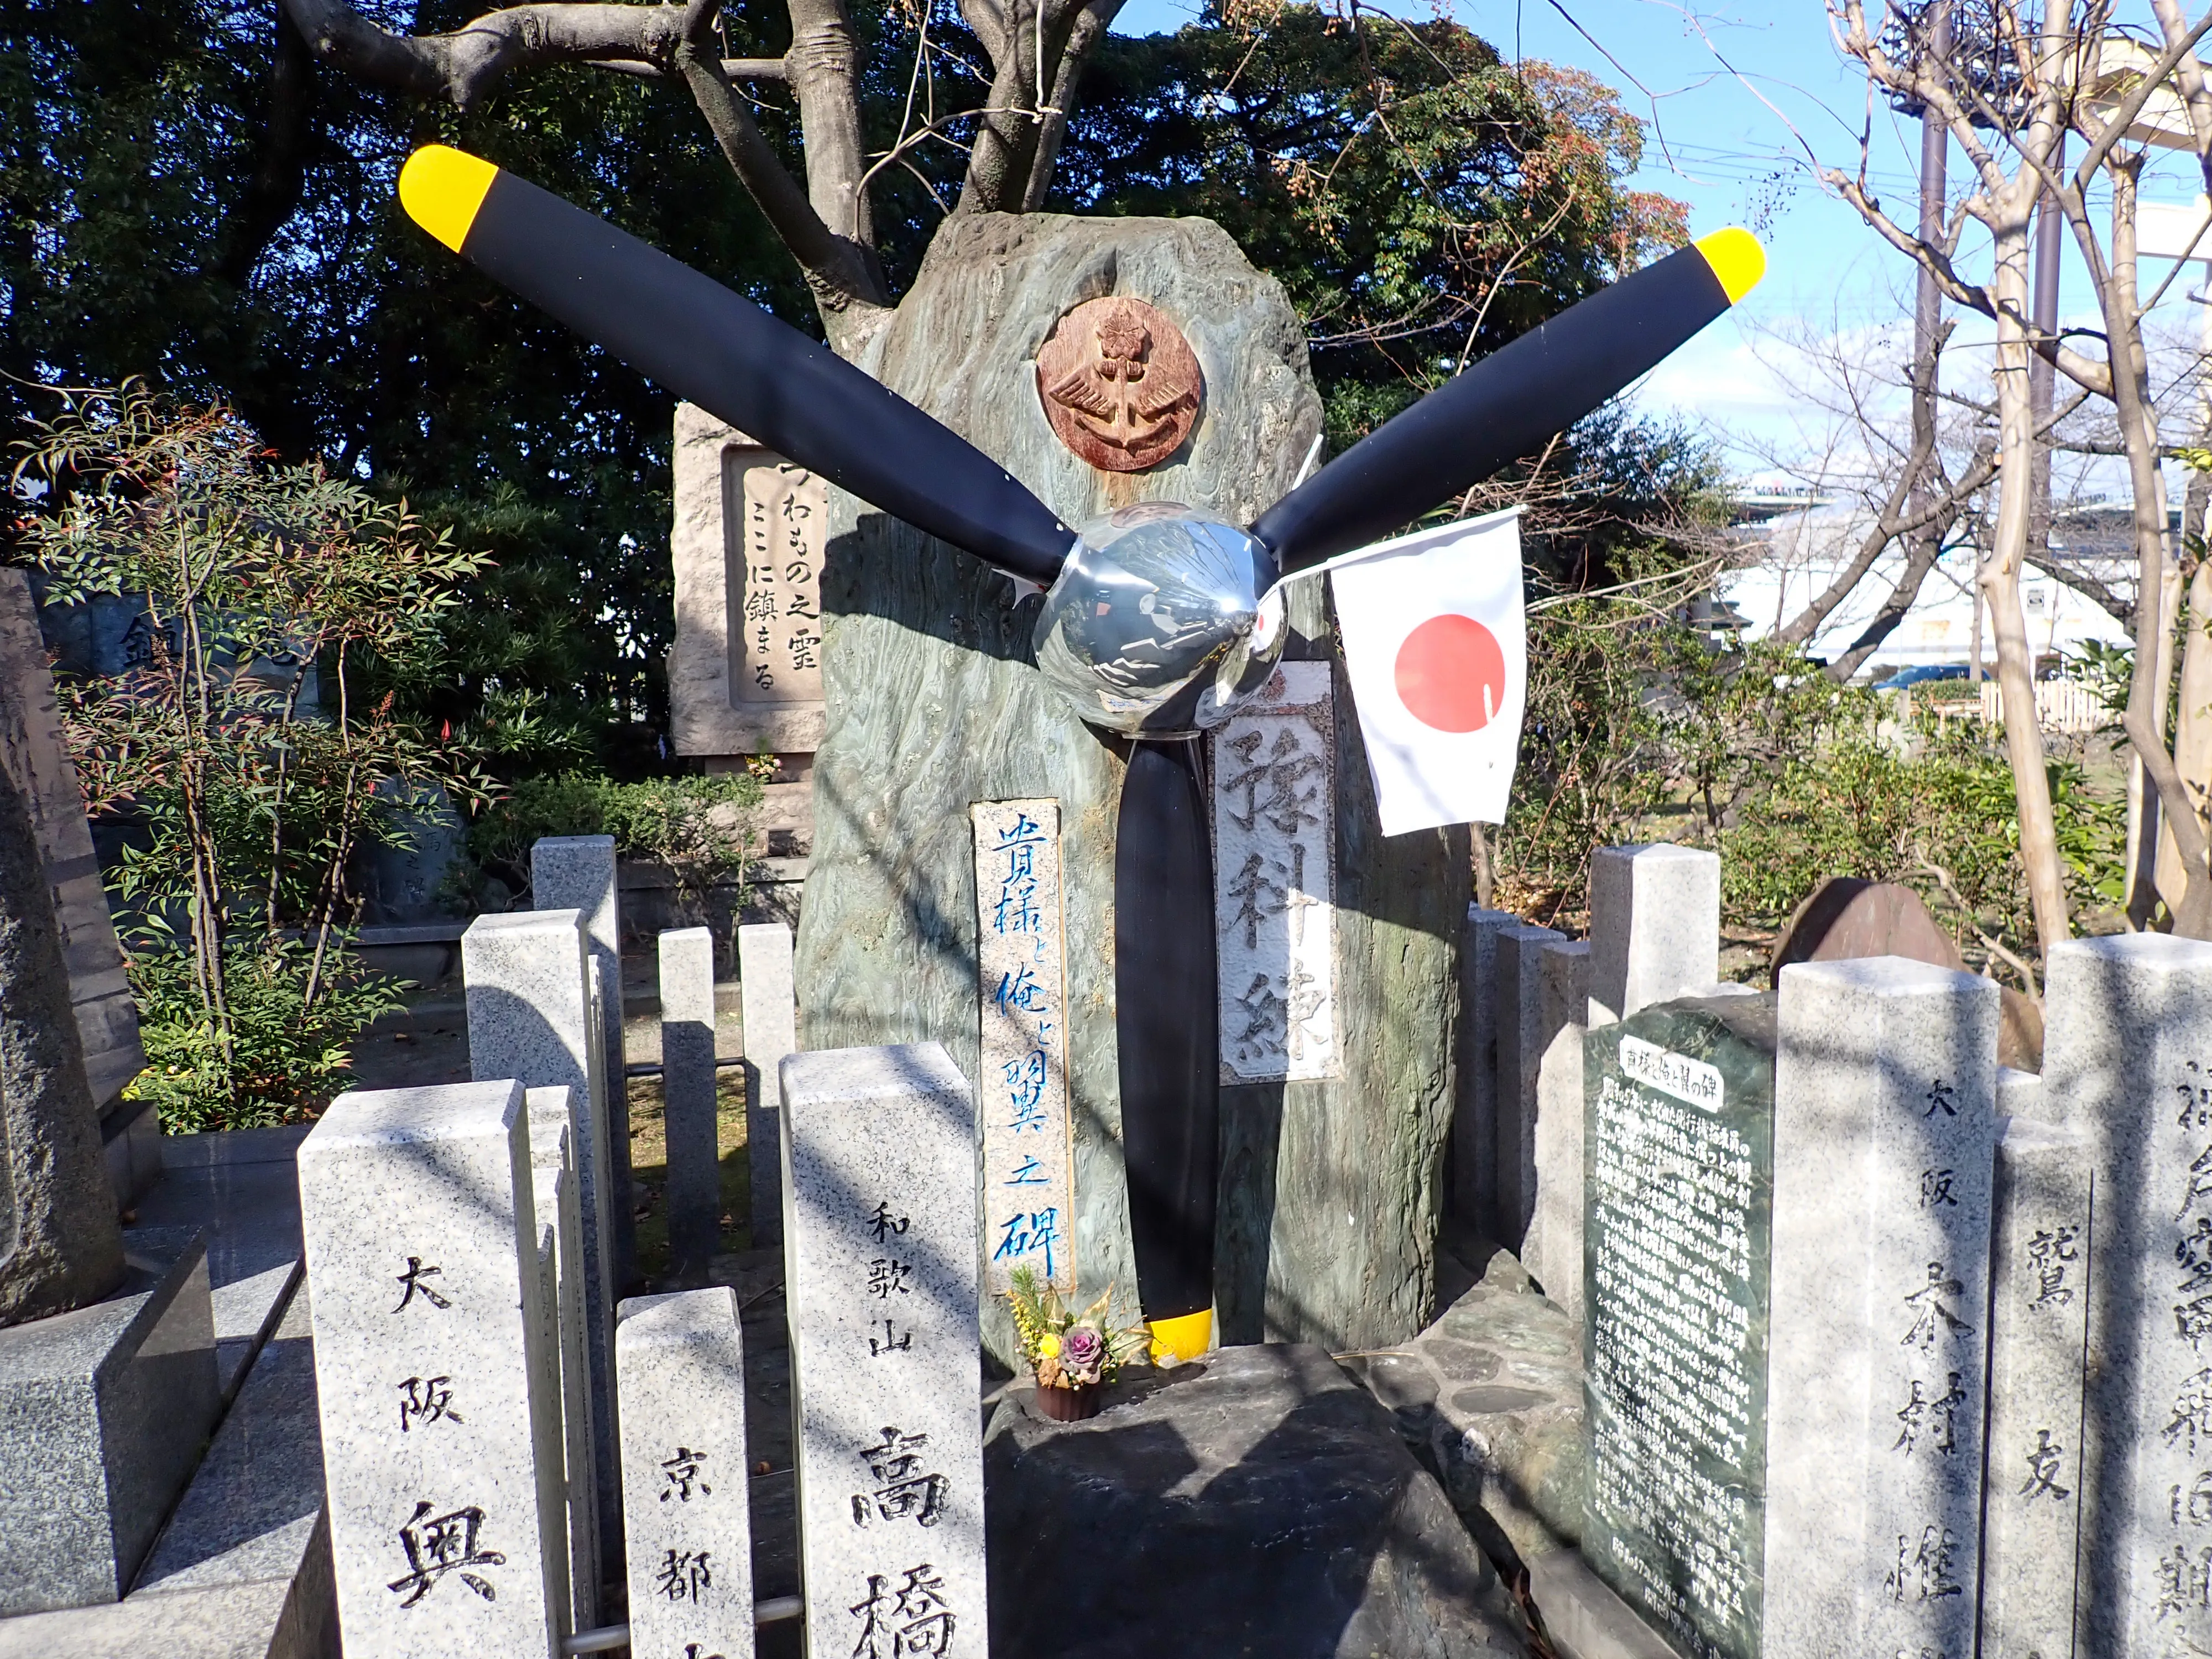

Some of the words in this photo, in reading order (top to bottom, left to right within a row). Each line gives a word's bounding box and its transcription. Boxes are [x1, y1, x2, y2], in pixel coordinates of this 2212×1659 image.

[745, 503, 778, 690] ここに鎮まる
[995, 812, 1059, 1276] 貴様と俺と翼之碑
[656, 1447, 726, 1659] 京都
